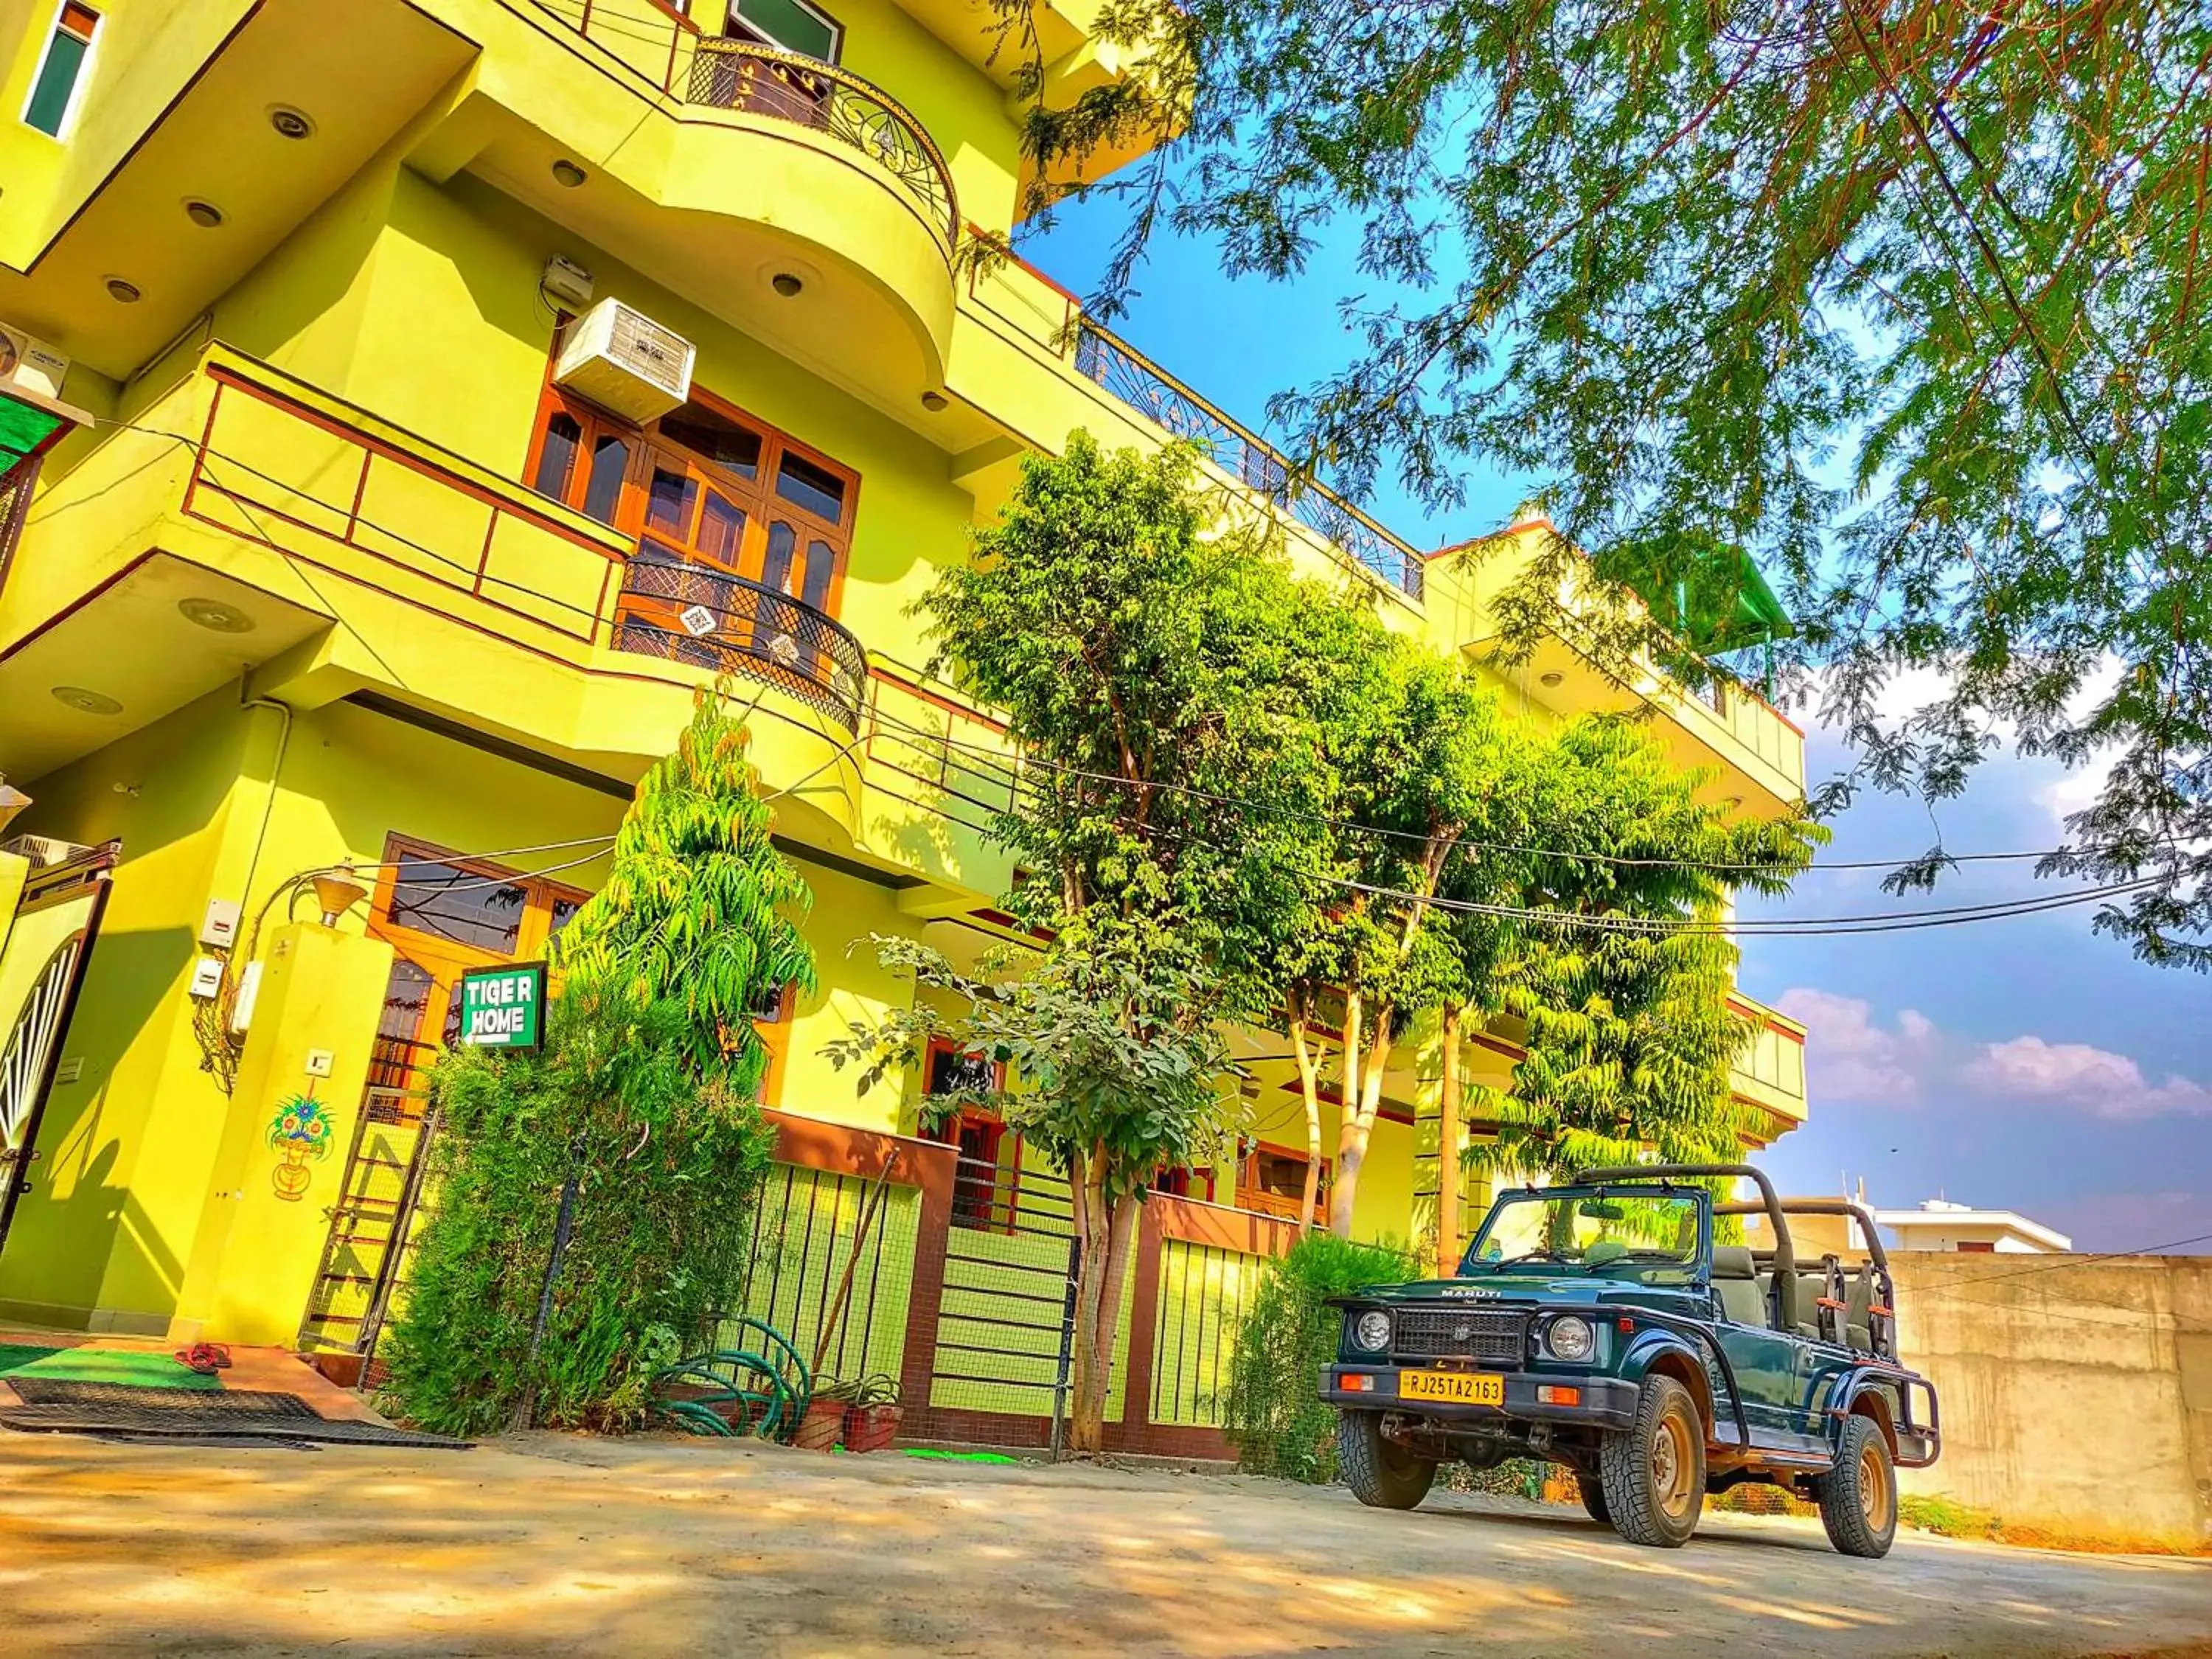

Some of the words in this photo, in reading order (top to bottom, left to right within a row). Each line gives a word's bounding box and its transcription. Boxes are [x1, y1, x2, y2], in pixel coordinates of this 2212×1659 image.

[467, 976, 532, 1006] TIGER
[472, 1007, 524, 1033] HOME
[1441, 1290, 1502, 1298] MARUTI
[1411, 1375, 1499, 1399] RJ25TA2163
